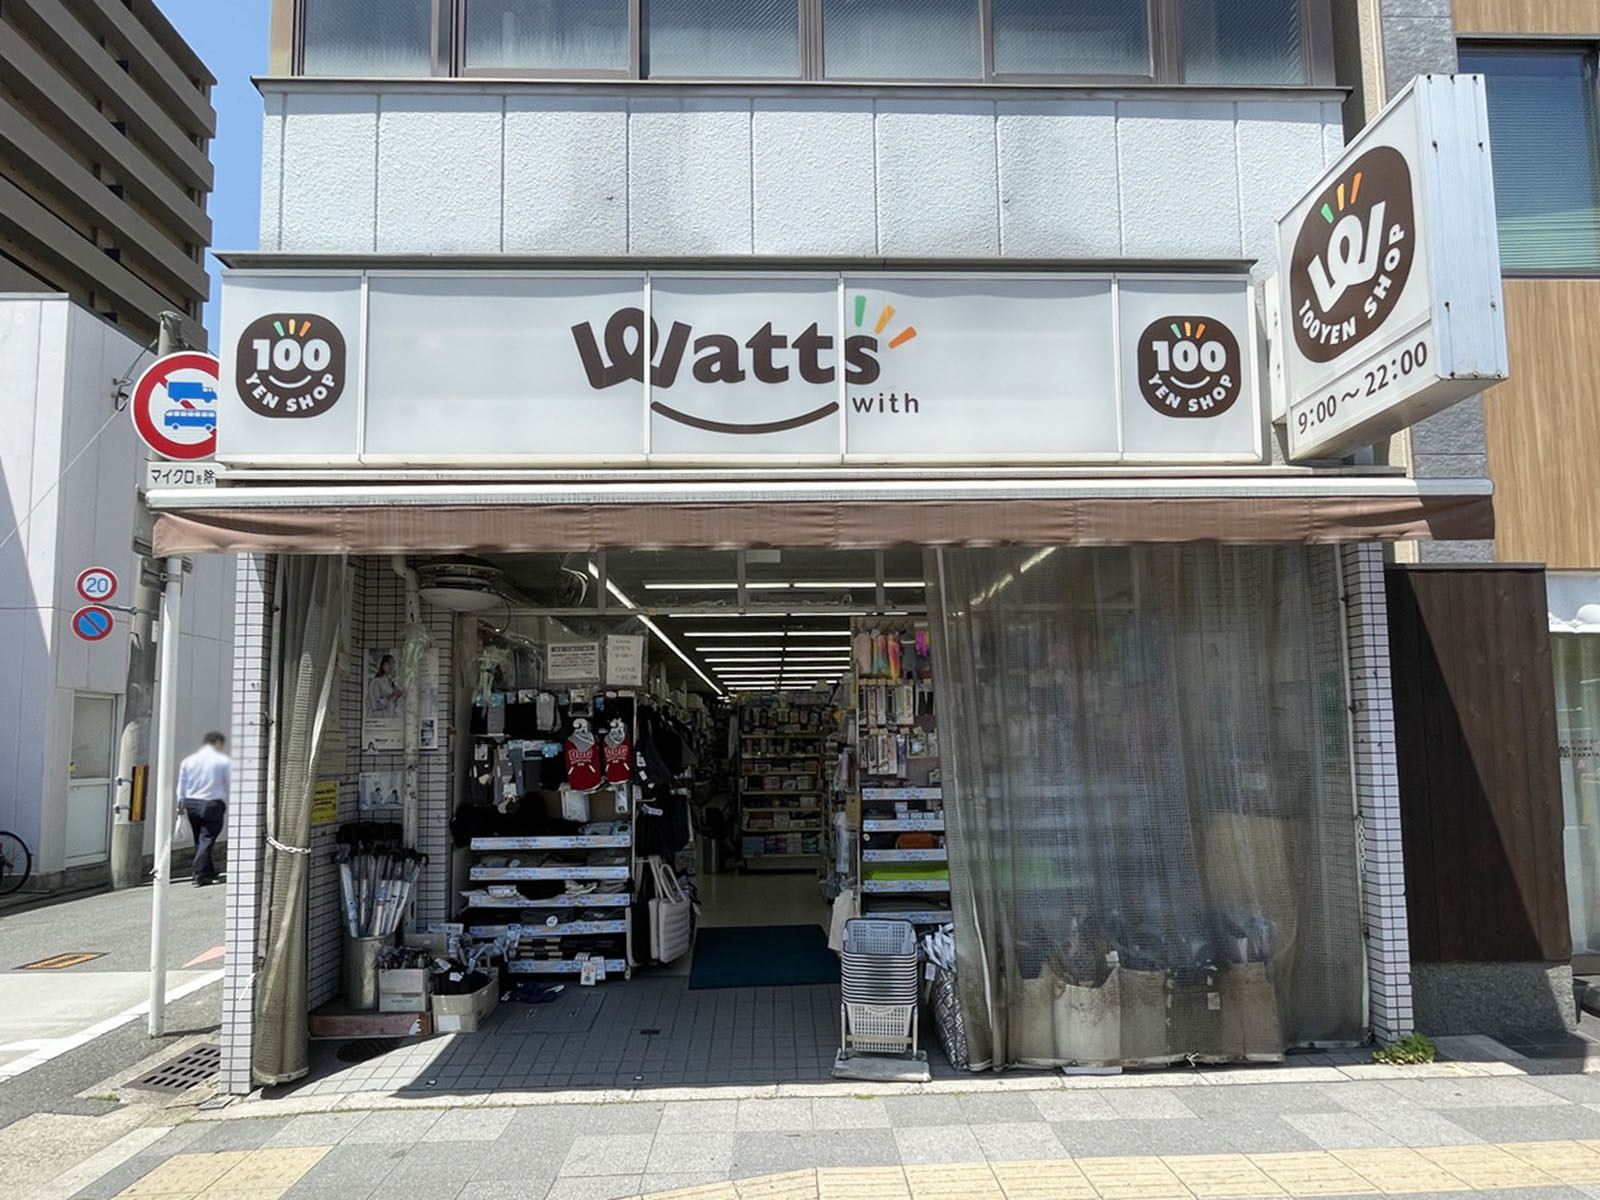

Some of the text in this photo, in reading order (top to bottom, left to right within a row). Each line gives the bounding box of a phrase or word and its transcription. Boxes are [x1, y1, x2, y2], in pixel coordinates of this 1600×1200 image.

[1298, 223, 1405, 345] 100YEN SHOP
[252, 338, 331, 372] 100
[570, 307, 881, 390] Watts
[1152, 340, 1227, 373] 100
[245, 372, 336, 413] YEN SHOP
[852, 392, 920, 414] with
[1148, 373, 1233, 412] YEN SHOP
[85, 577, 108, 593] 20
